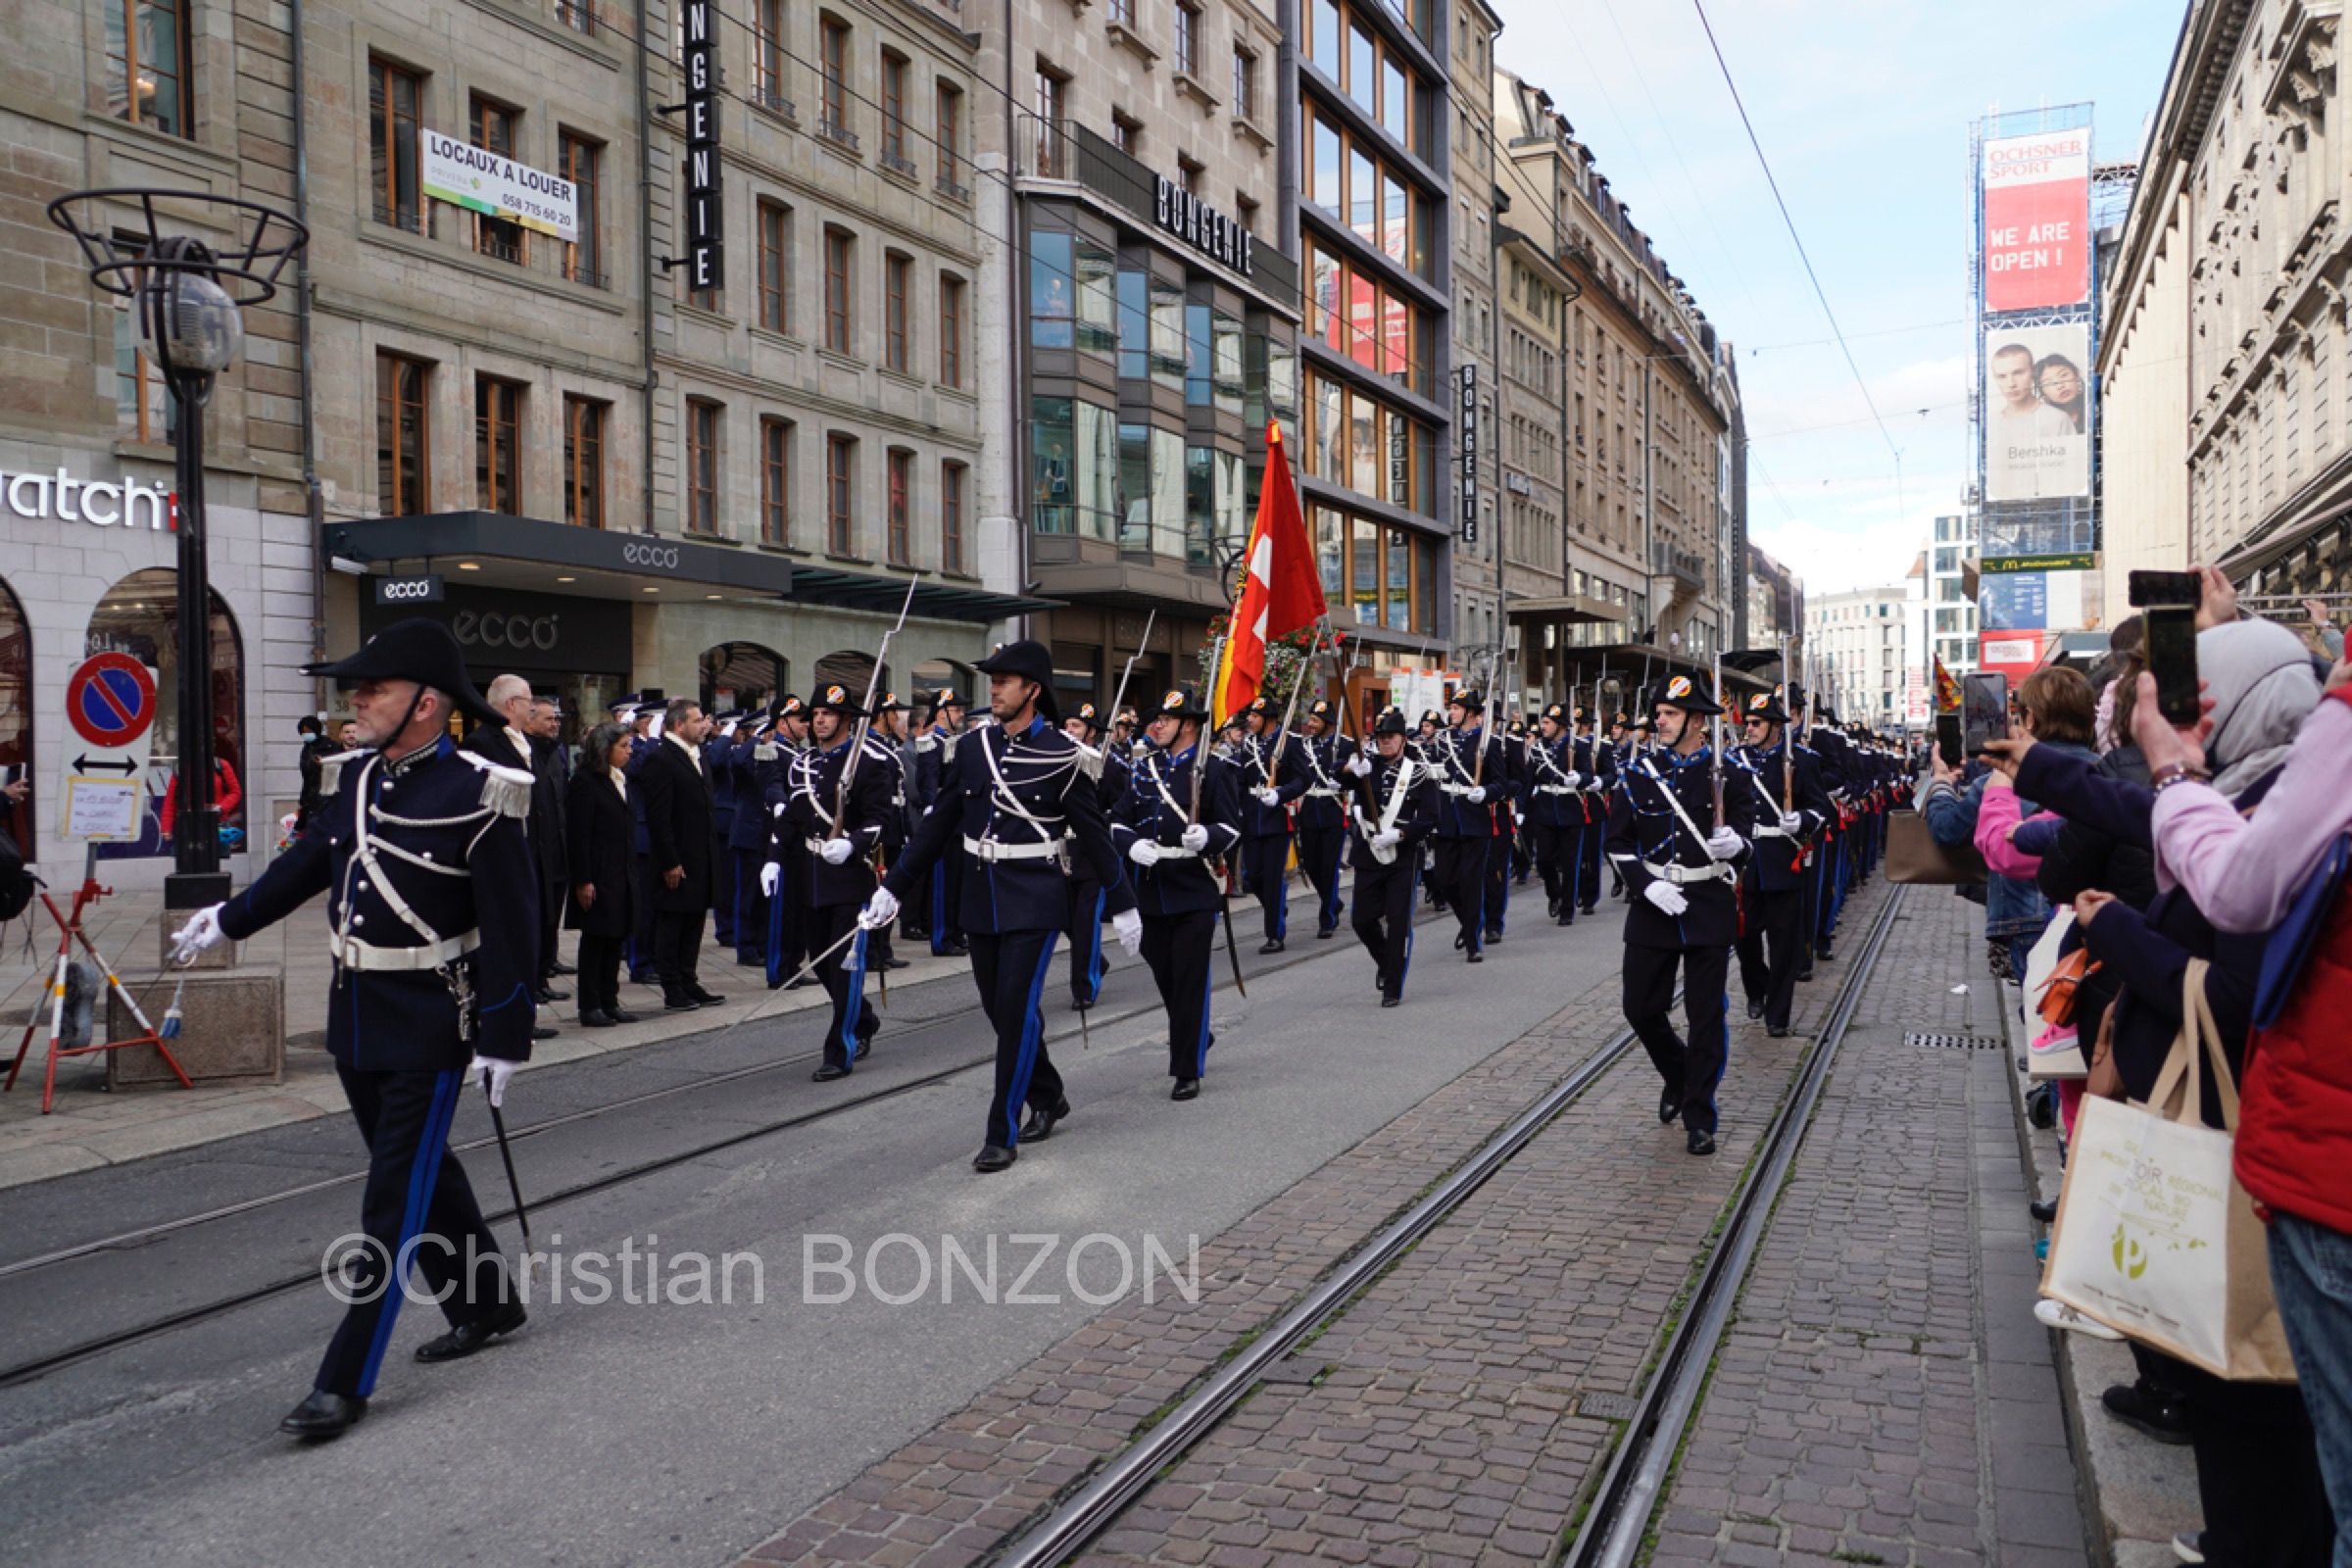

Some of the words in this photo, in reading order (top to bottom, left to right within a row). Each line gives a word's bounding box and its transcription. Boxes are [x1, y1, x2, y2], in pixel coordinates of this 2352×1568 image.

[1990, 140, 2082, 164] OCHSNER
[430, 135, 499, 176] LOCAUX
[503, 163, 514, 183] A
[518, 168, 571, 202] LOUER
[1990, 160, 2052, 179] SPORT
[502, 193, 521, 211] 058
[524, 199, 542, 217] 715
[543, 207, 558, 221] 60
[559, 213, 571, 226] 20
[1159, 175, 1253, 275] BONGENIE
[1990, 226, 2020, 247] WE
[2028, 221, 2071, 244] ARE
[1990, 248, 2048, 271] OPEN
[2056, 247, 2063, 266] !
[1464, 367, 1475, 541] BONGENIE
[2008, 444, 2067, 460] Bershka
[0, 466, 165, 530] atch
[622, 542, 679, 569] ecco
[384, 579, 429, 599] ecco
[453, 610, 560, 651] ecco
